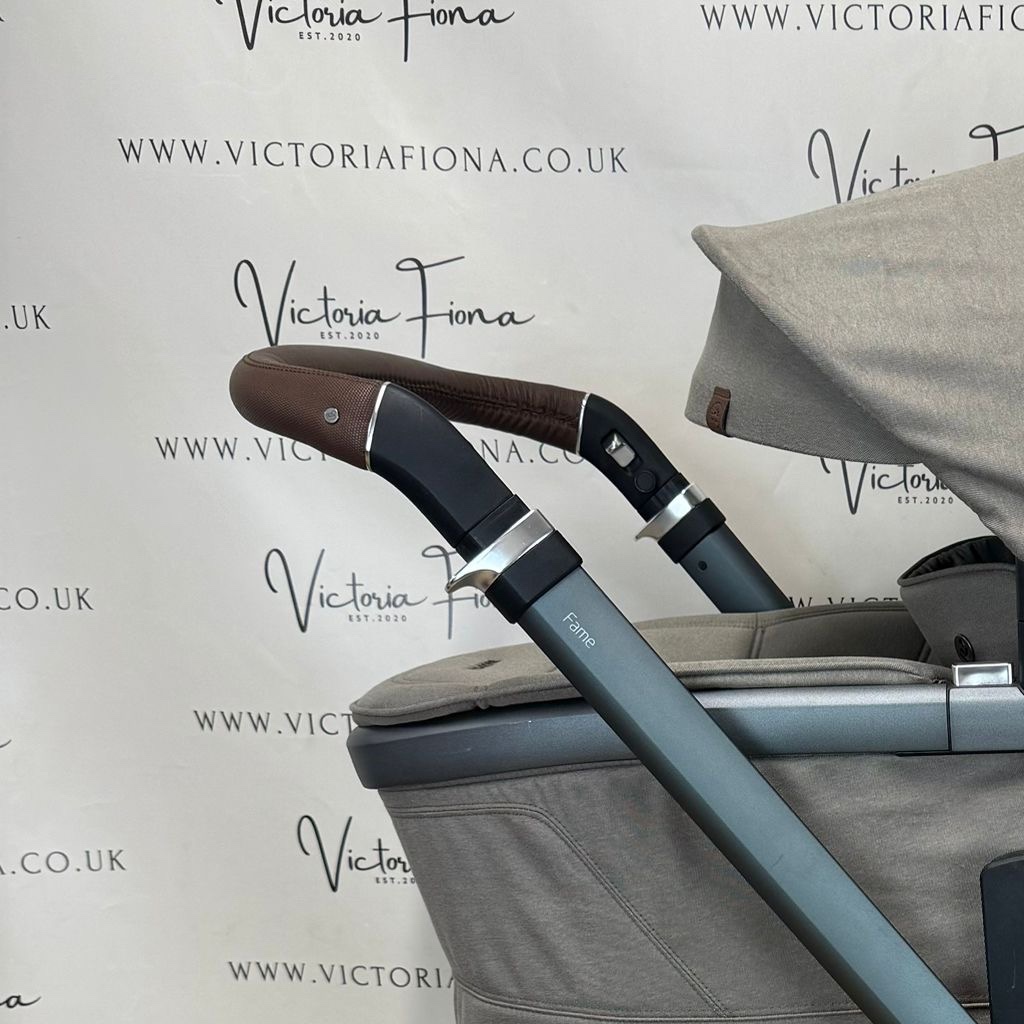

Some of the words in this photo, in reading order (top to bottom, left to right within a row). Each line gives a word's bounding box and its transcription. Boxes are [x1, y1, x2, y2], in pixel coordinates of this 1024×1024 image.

[299, 32, 361, 41] EST.2020
[117, 137, 628, 174] WWW.VICTORIAFIONA.CO.UK
[233, 259, 401, 346] Victoria
[396, 256, 535, 359] Fiona
[319, 331, 380, 340] EST.2020
[264, 547, 428, 634] Victoria
[348, 614, 407, 622] EST.2020
[562, 612, 595, 649] Fame
